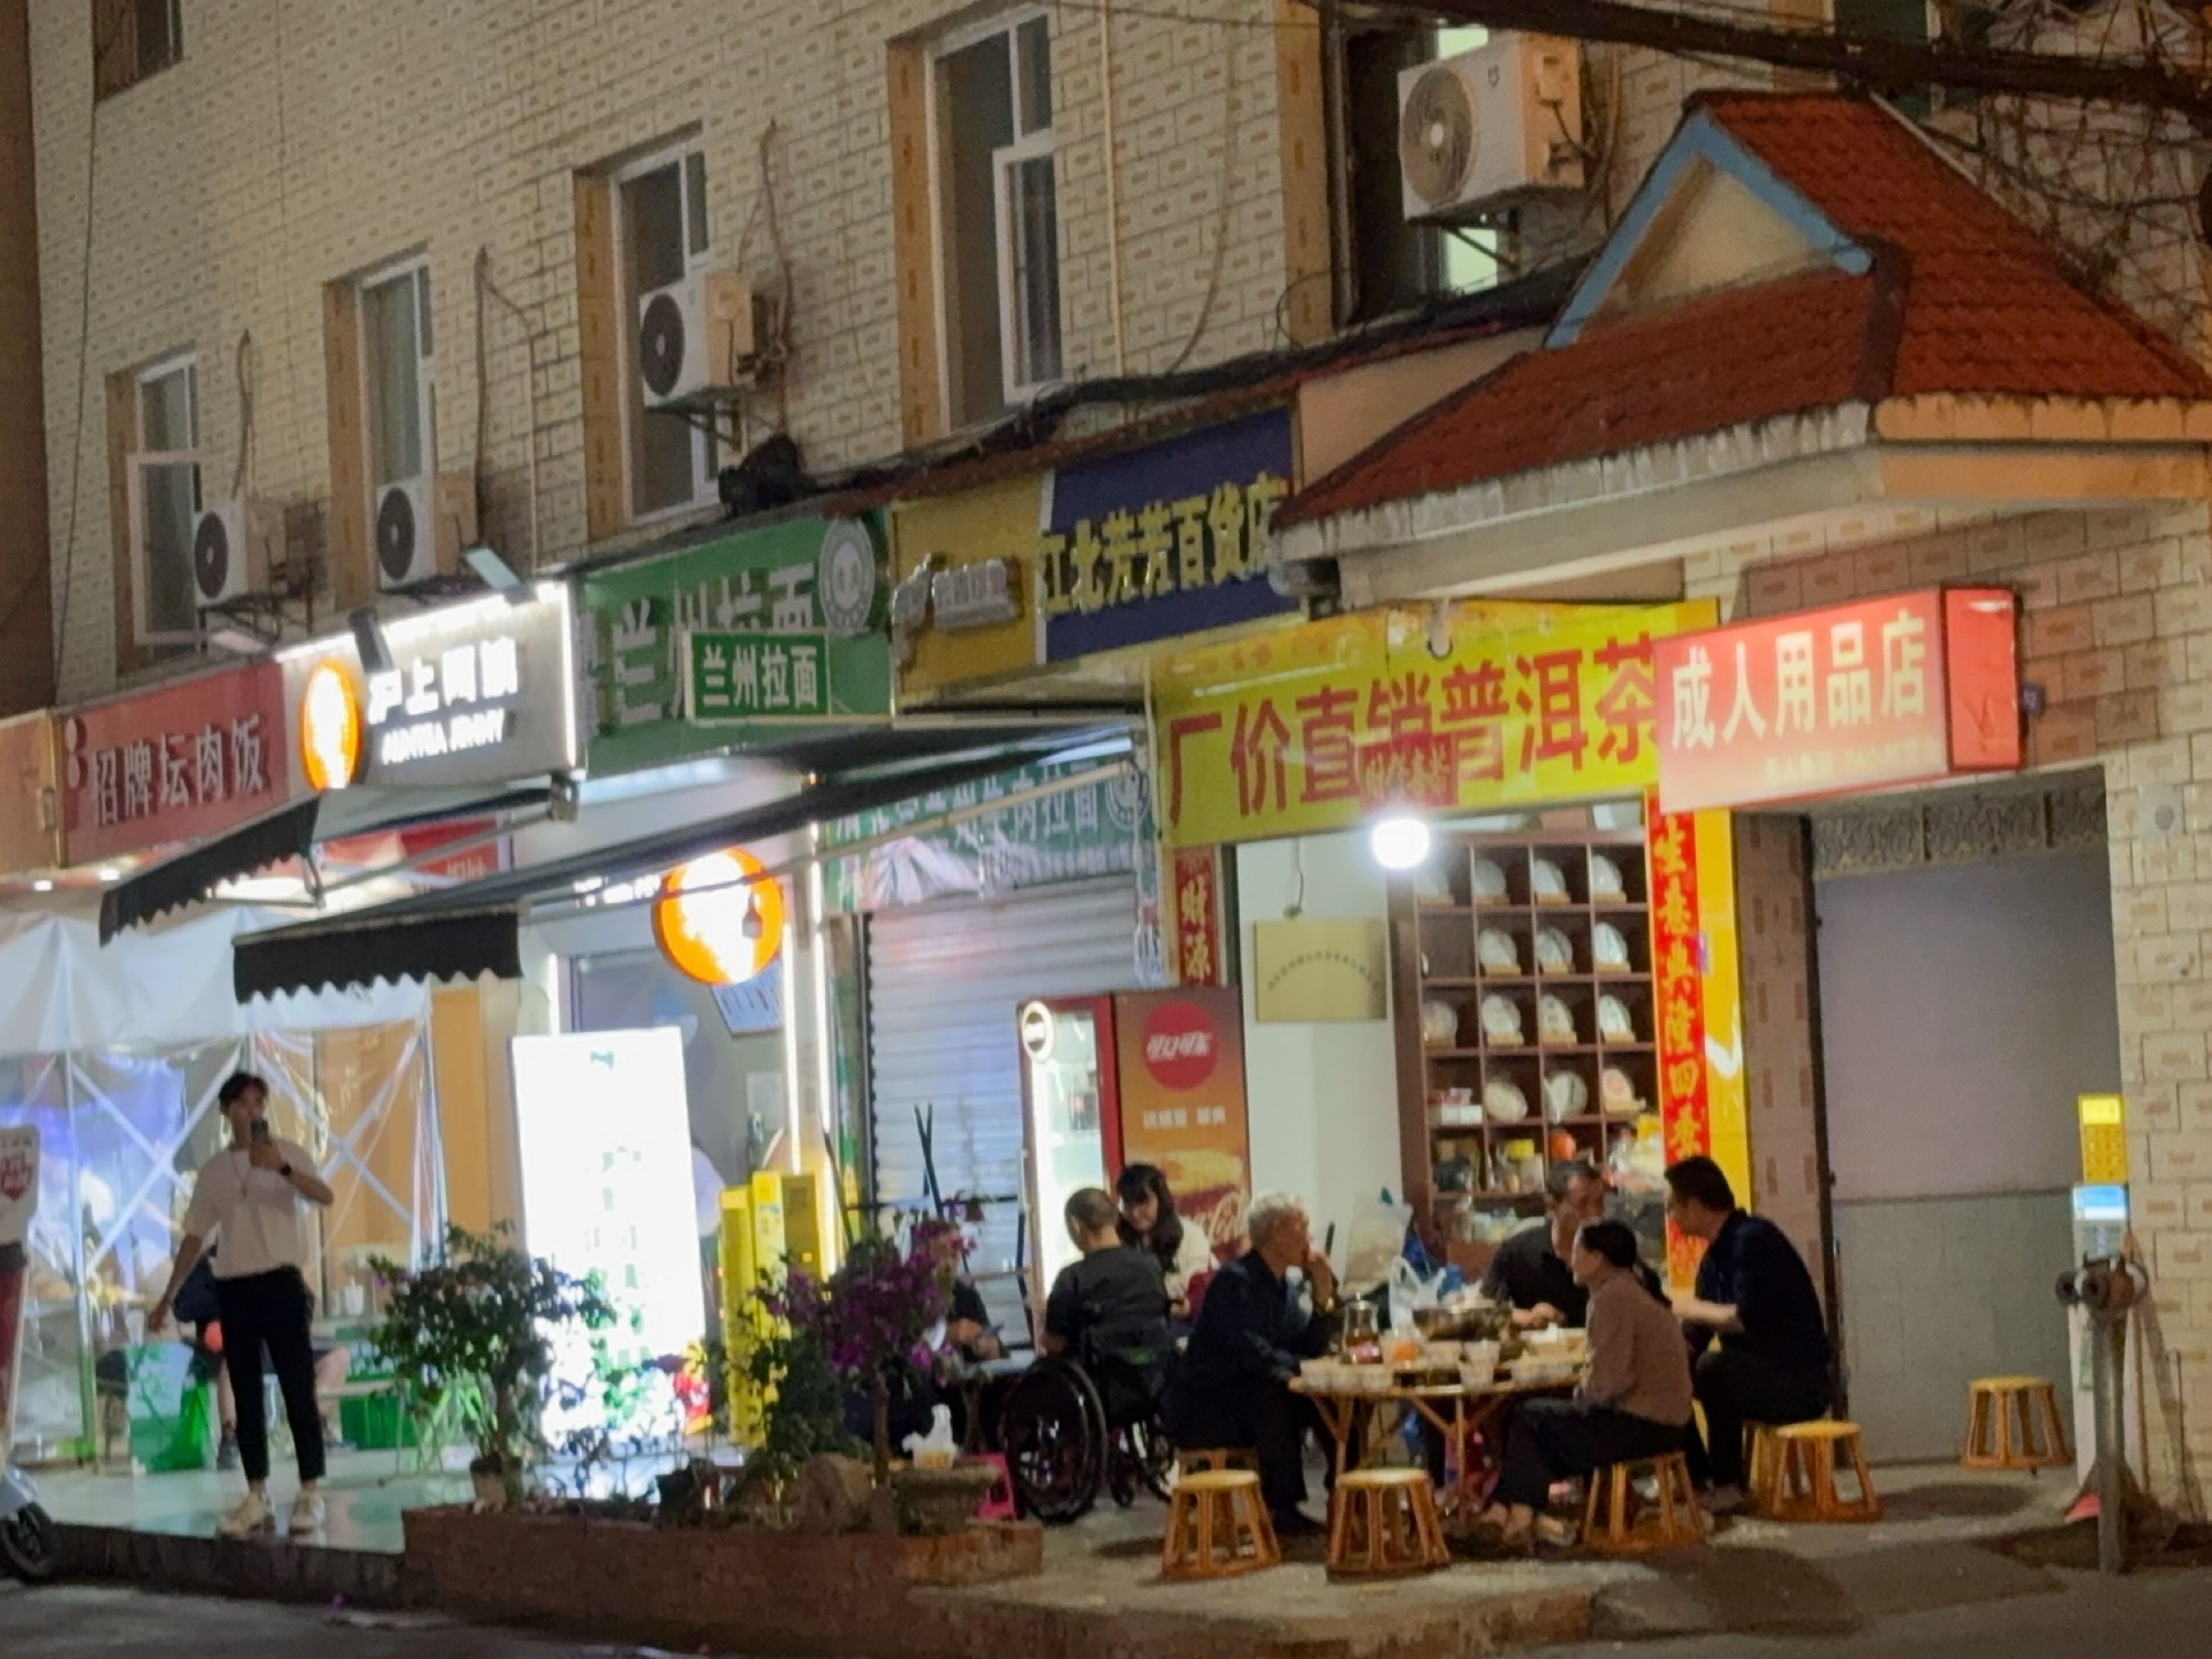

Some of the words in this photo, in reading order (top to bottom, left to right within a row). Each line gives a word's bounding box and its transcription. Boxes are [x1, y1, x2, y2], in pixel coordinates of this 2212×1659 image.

[702, 643, 819, 709] 兰州拉面
[1168, 630, 1655, 827] 厂价直销普洱茶
[1671, 606, 1927, 751] 成人用品店
[93, 712, 264, 827] 招牌坛肉饭
